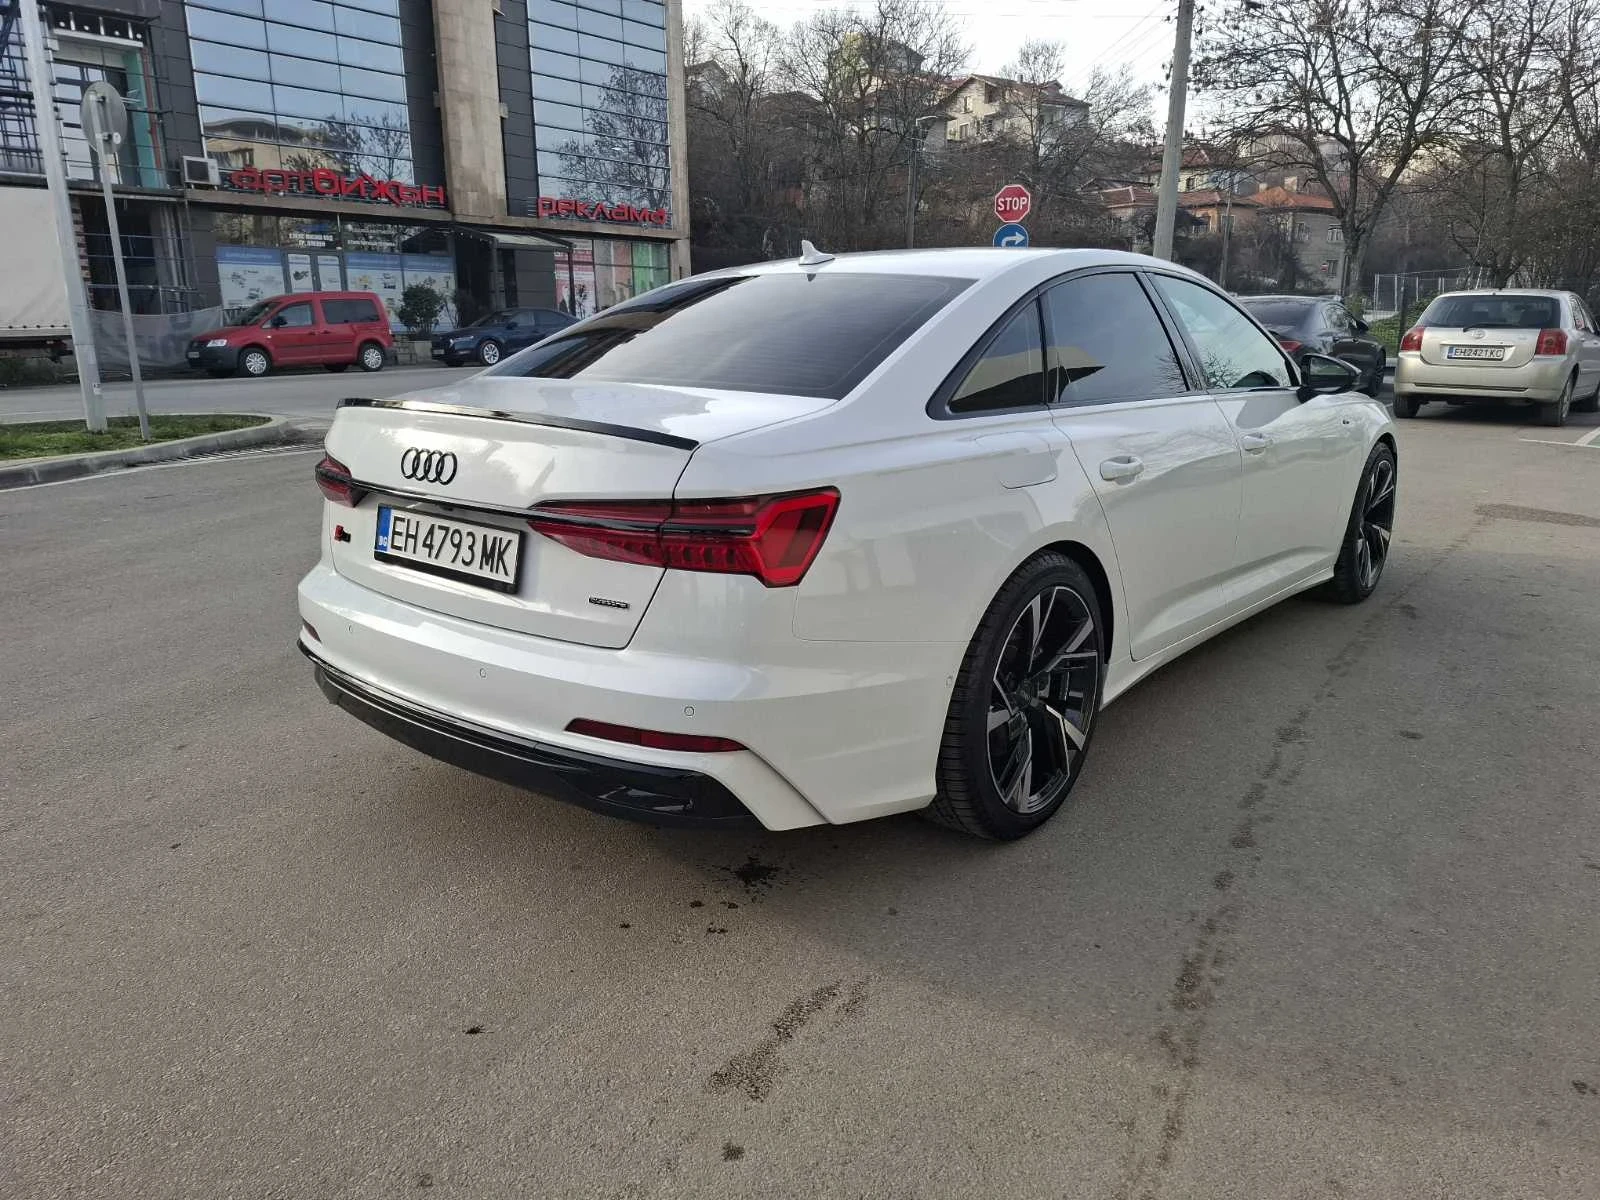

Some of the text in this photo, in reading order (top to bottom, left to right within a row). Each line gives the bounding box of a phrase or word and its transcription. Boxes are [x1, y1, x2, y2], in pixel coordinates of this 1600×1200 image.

[997, 197, 1028, 211] STOP
[422, 523, 476, 567] 4793
[479, 533, 513, 577] MK
